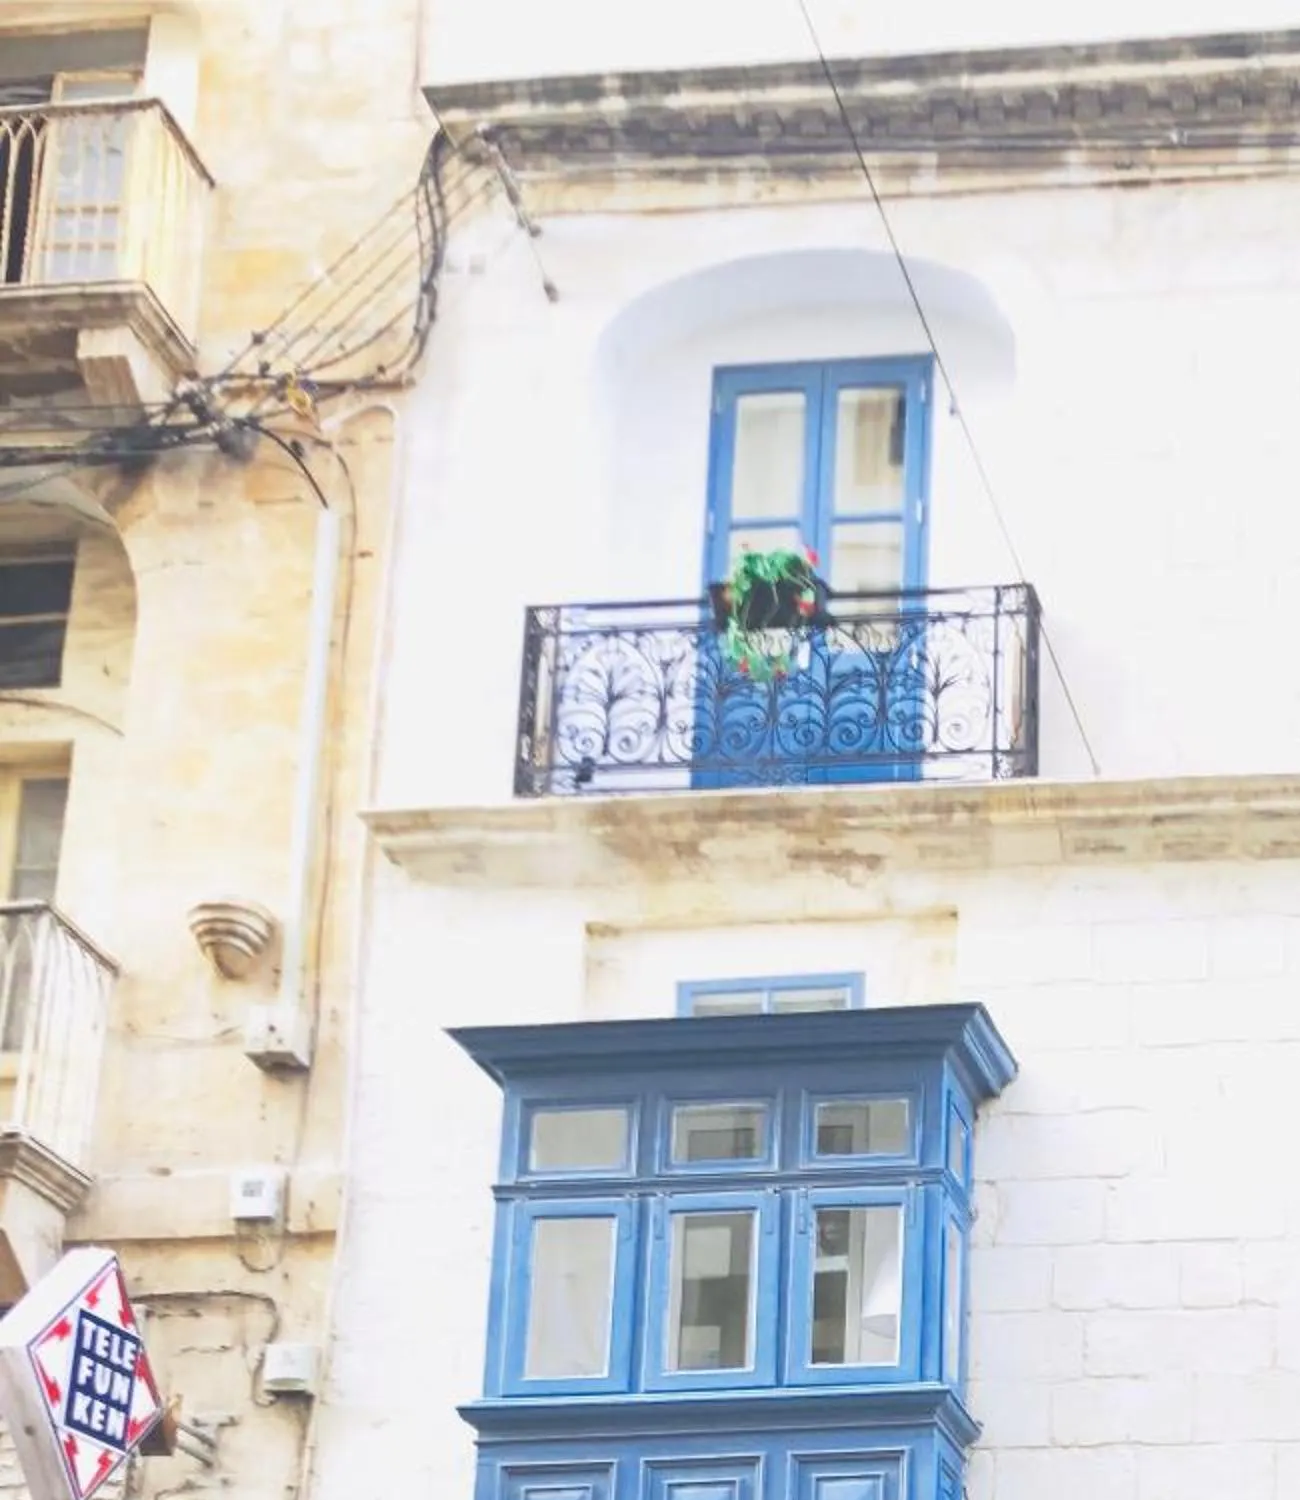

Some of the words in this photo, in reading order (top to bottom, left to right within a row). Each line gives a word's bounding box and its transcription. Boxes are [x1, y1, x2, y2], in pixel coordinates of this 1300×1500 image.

[81, 1317, 137, 1371] TELE
[77, 1355, 131, 1405] FUN
[73, 1391, 126, 1440] KEN
